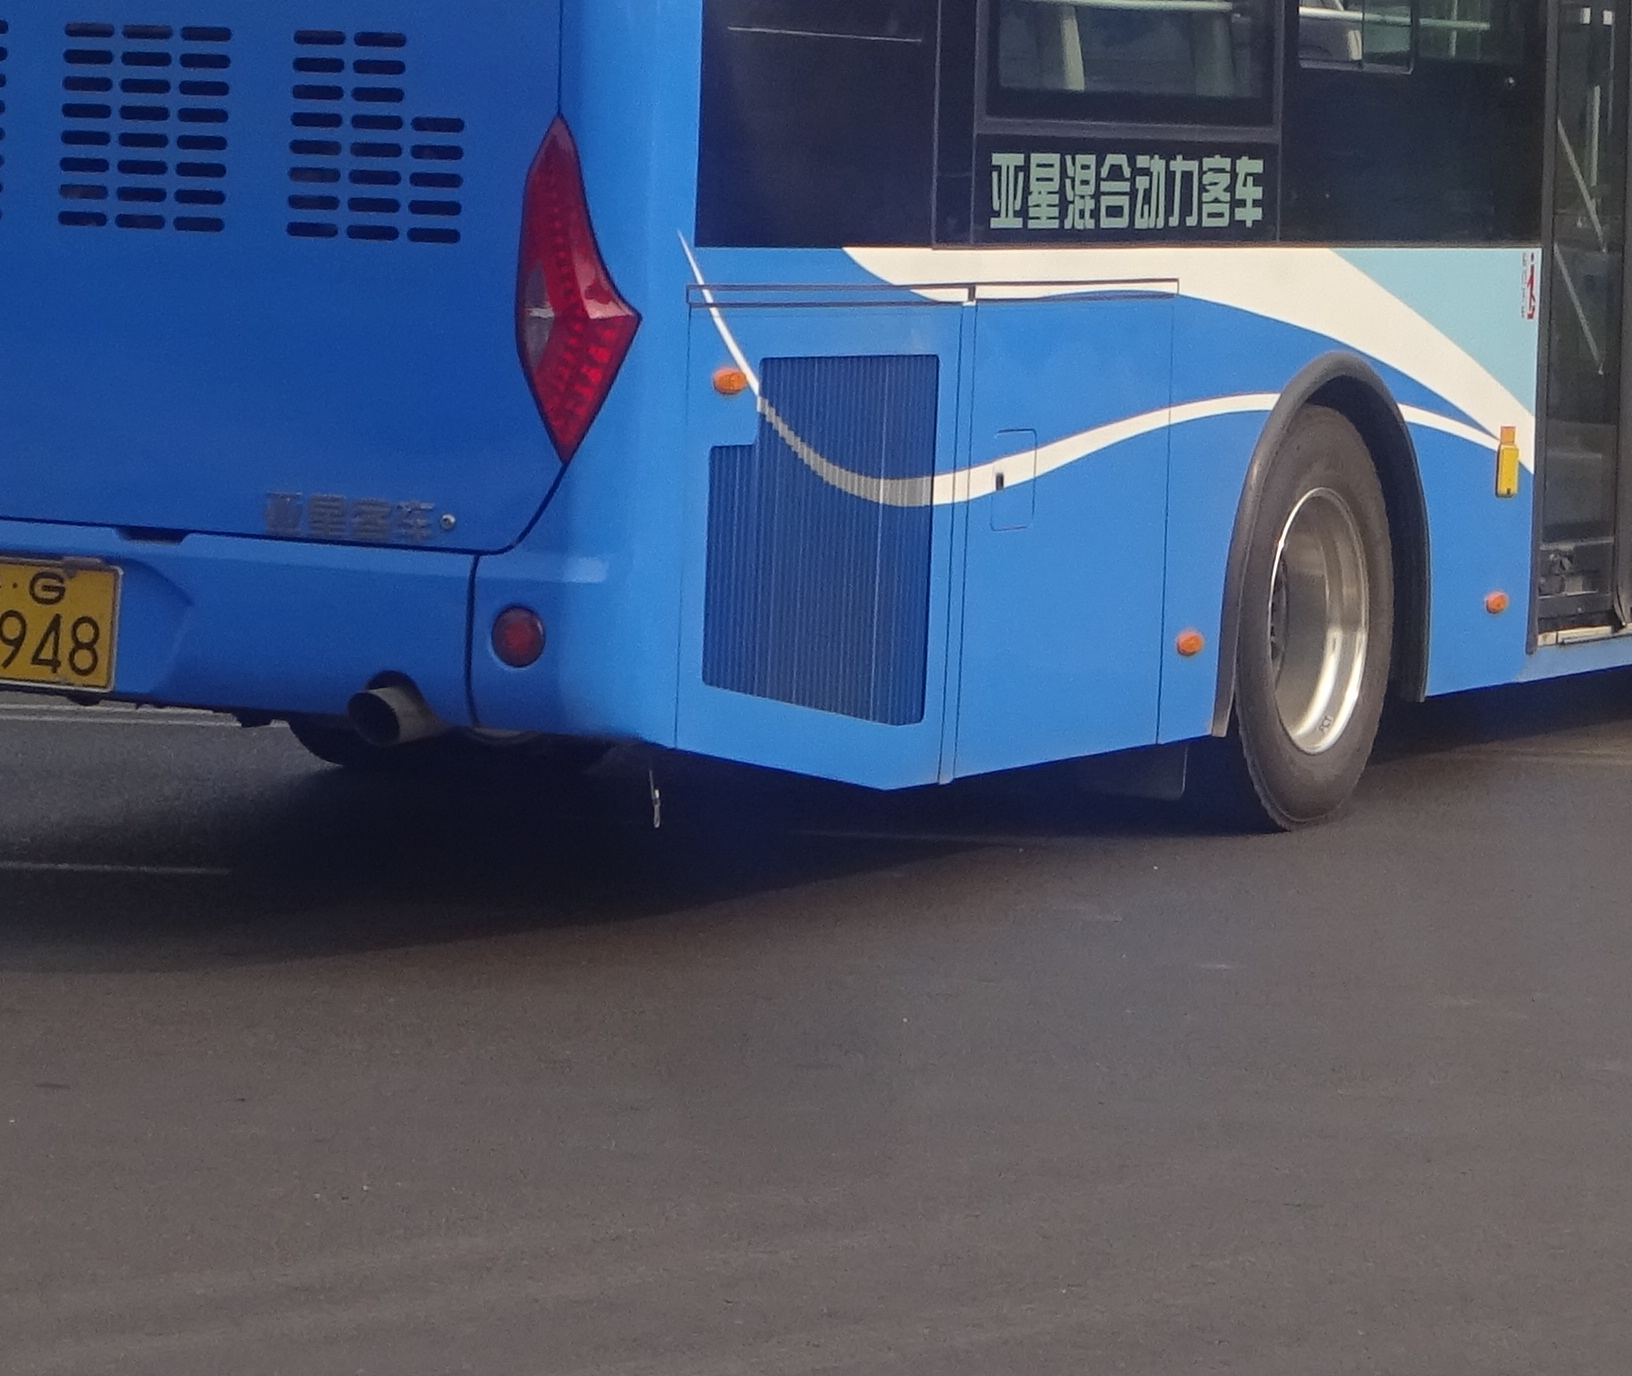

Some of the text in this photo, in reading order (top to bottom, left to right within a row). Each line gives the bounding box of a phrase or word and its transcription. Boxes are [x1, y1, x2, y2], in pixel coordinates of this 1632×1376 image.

[989, 152, 1264, 230] 亚星混合动力客车
